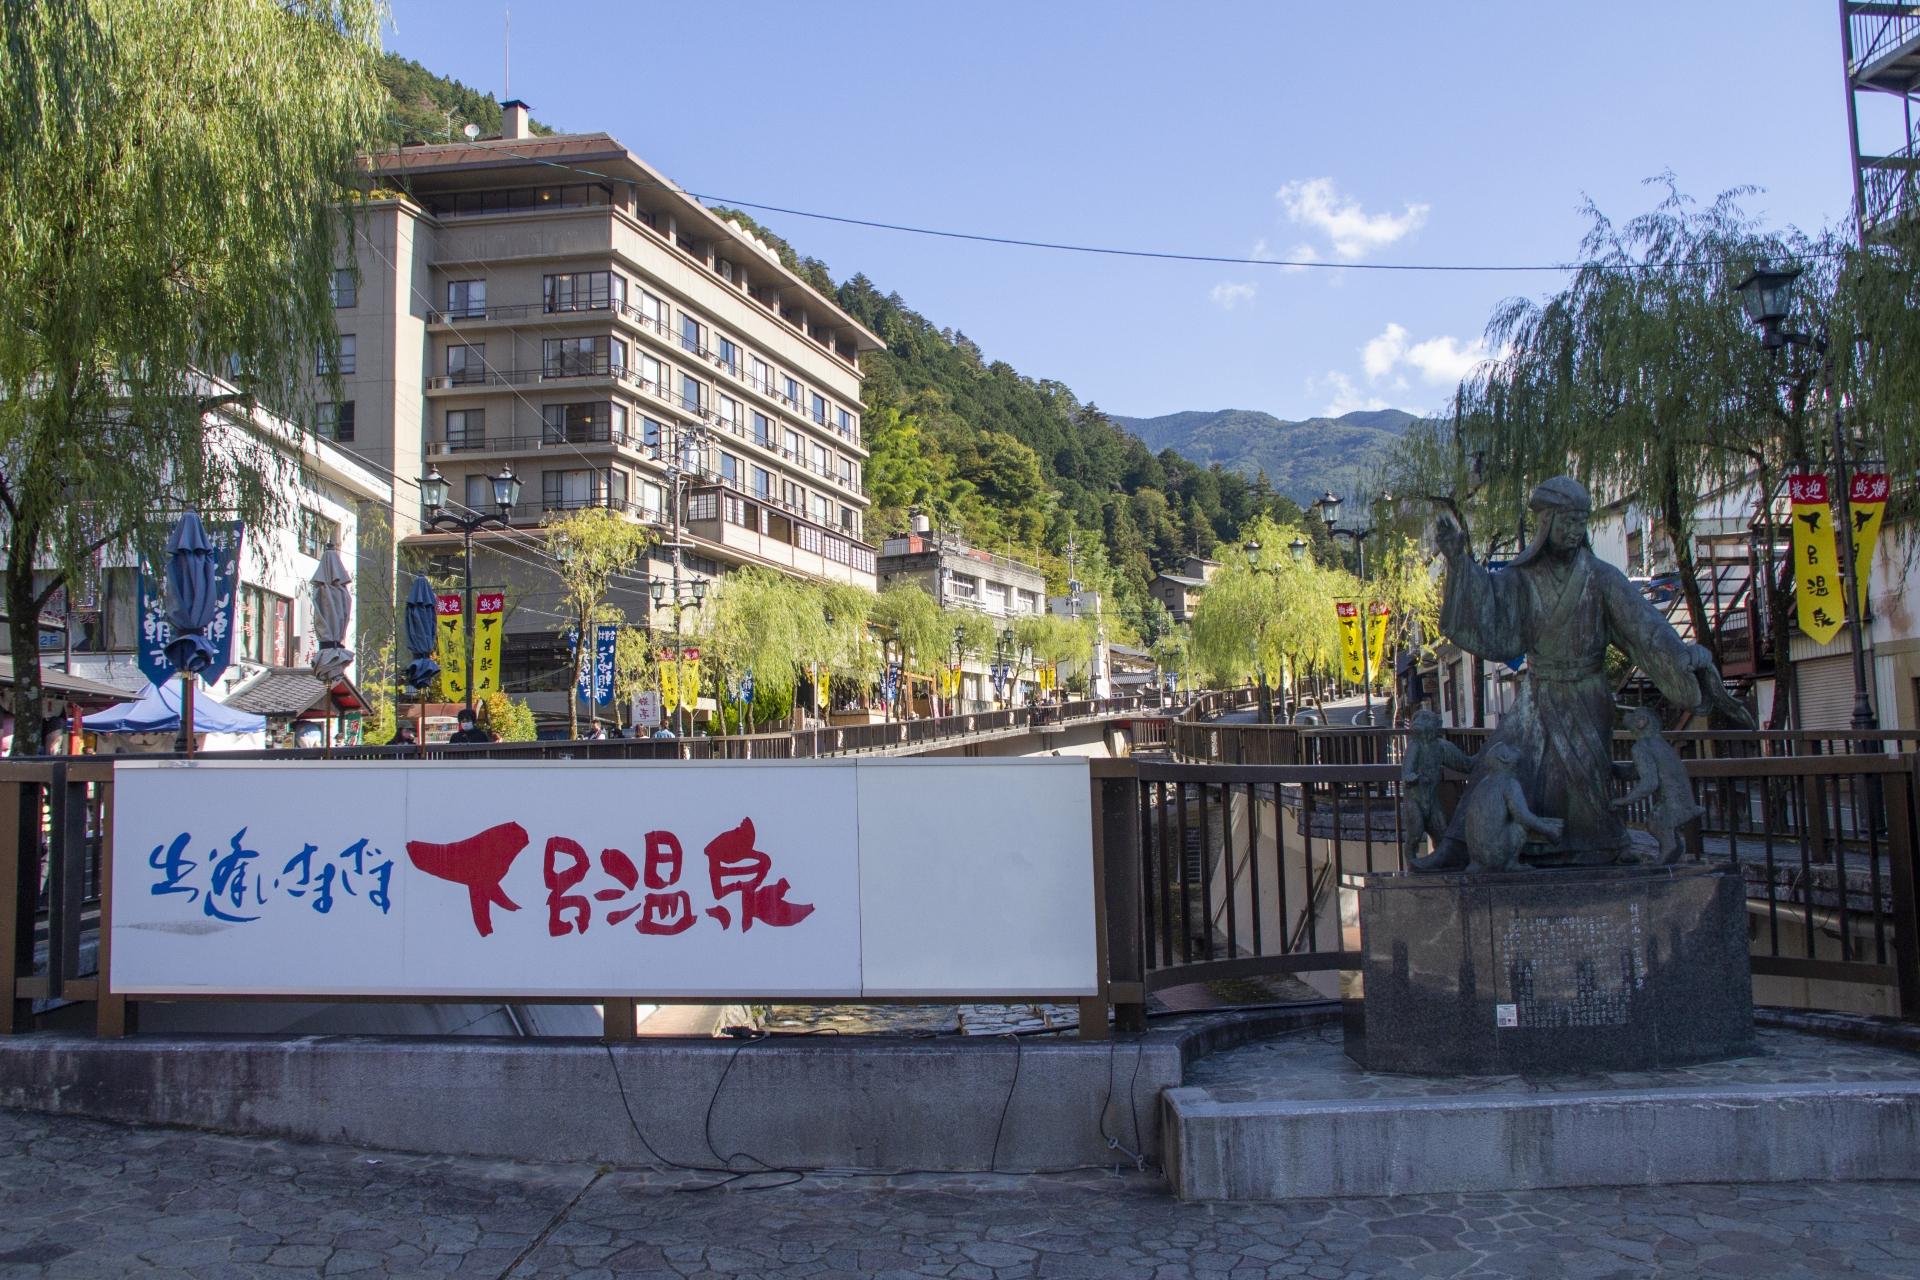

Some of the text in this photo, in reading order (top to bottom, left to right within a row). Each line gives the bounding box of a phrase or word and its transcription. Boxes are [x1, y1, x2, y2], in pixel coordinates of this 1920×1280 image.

[1797, 511, 1836, 628] 下呂温泉
[406, 816, 815, 938] 下呂温泉
